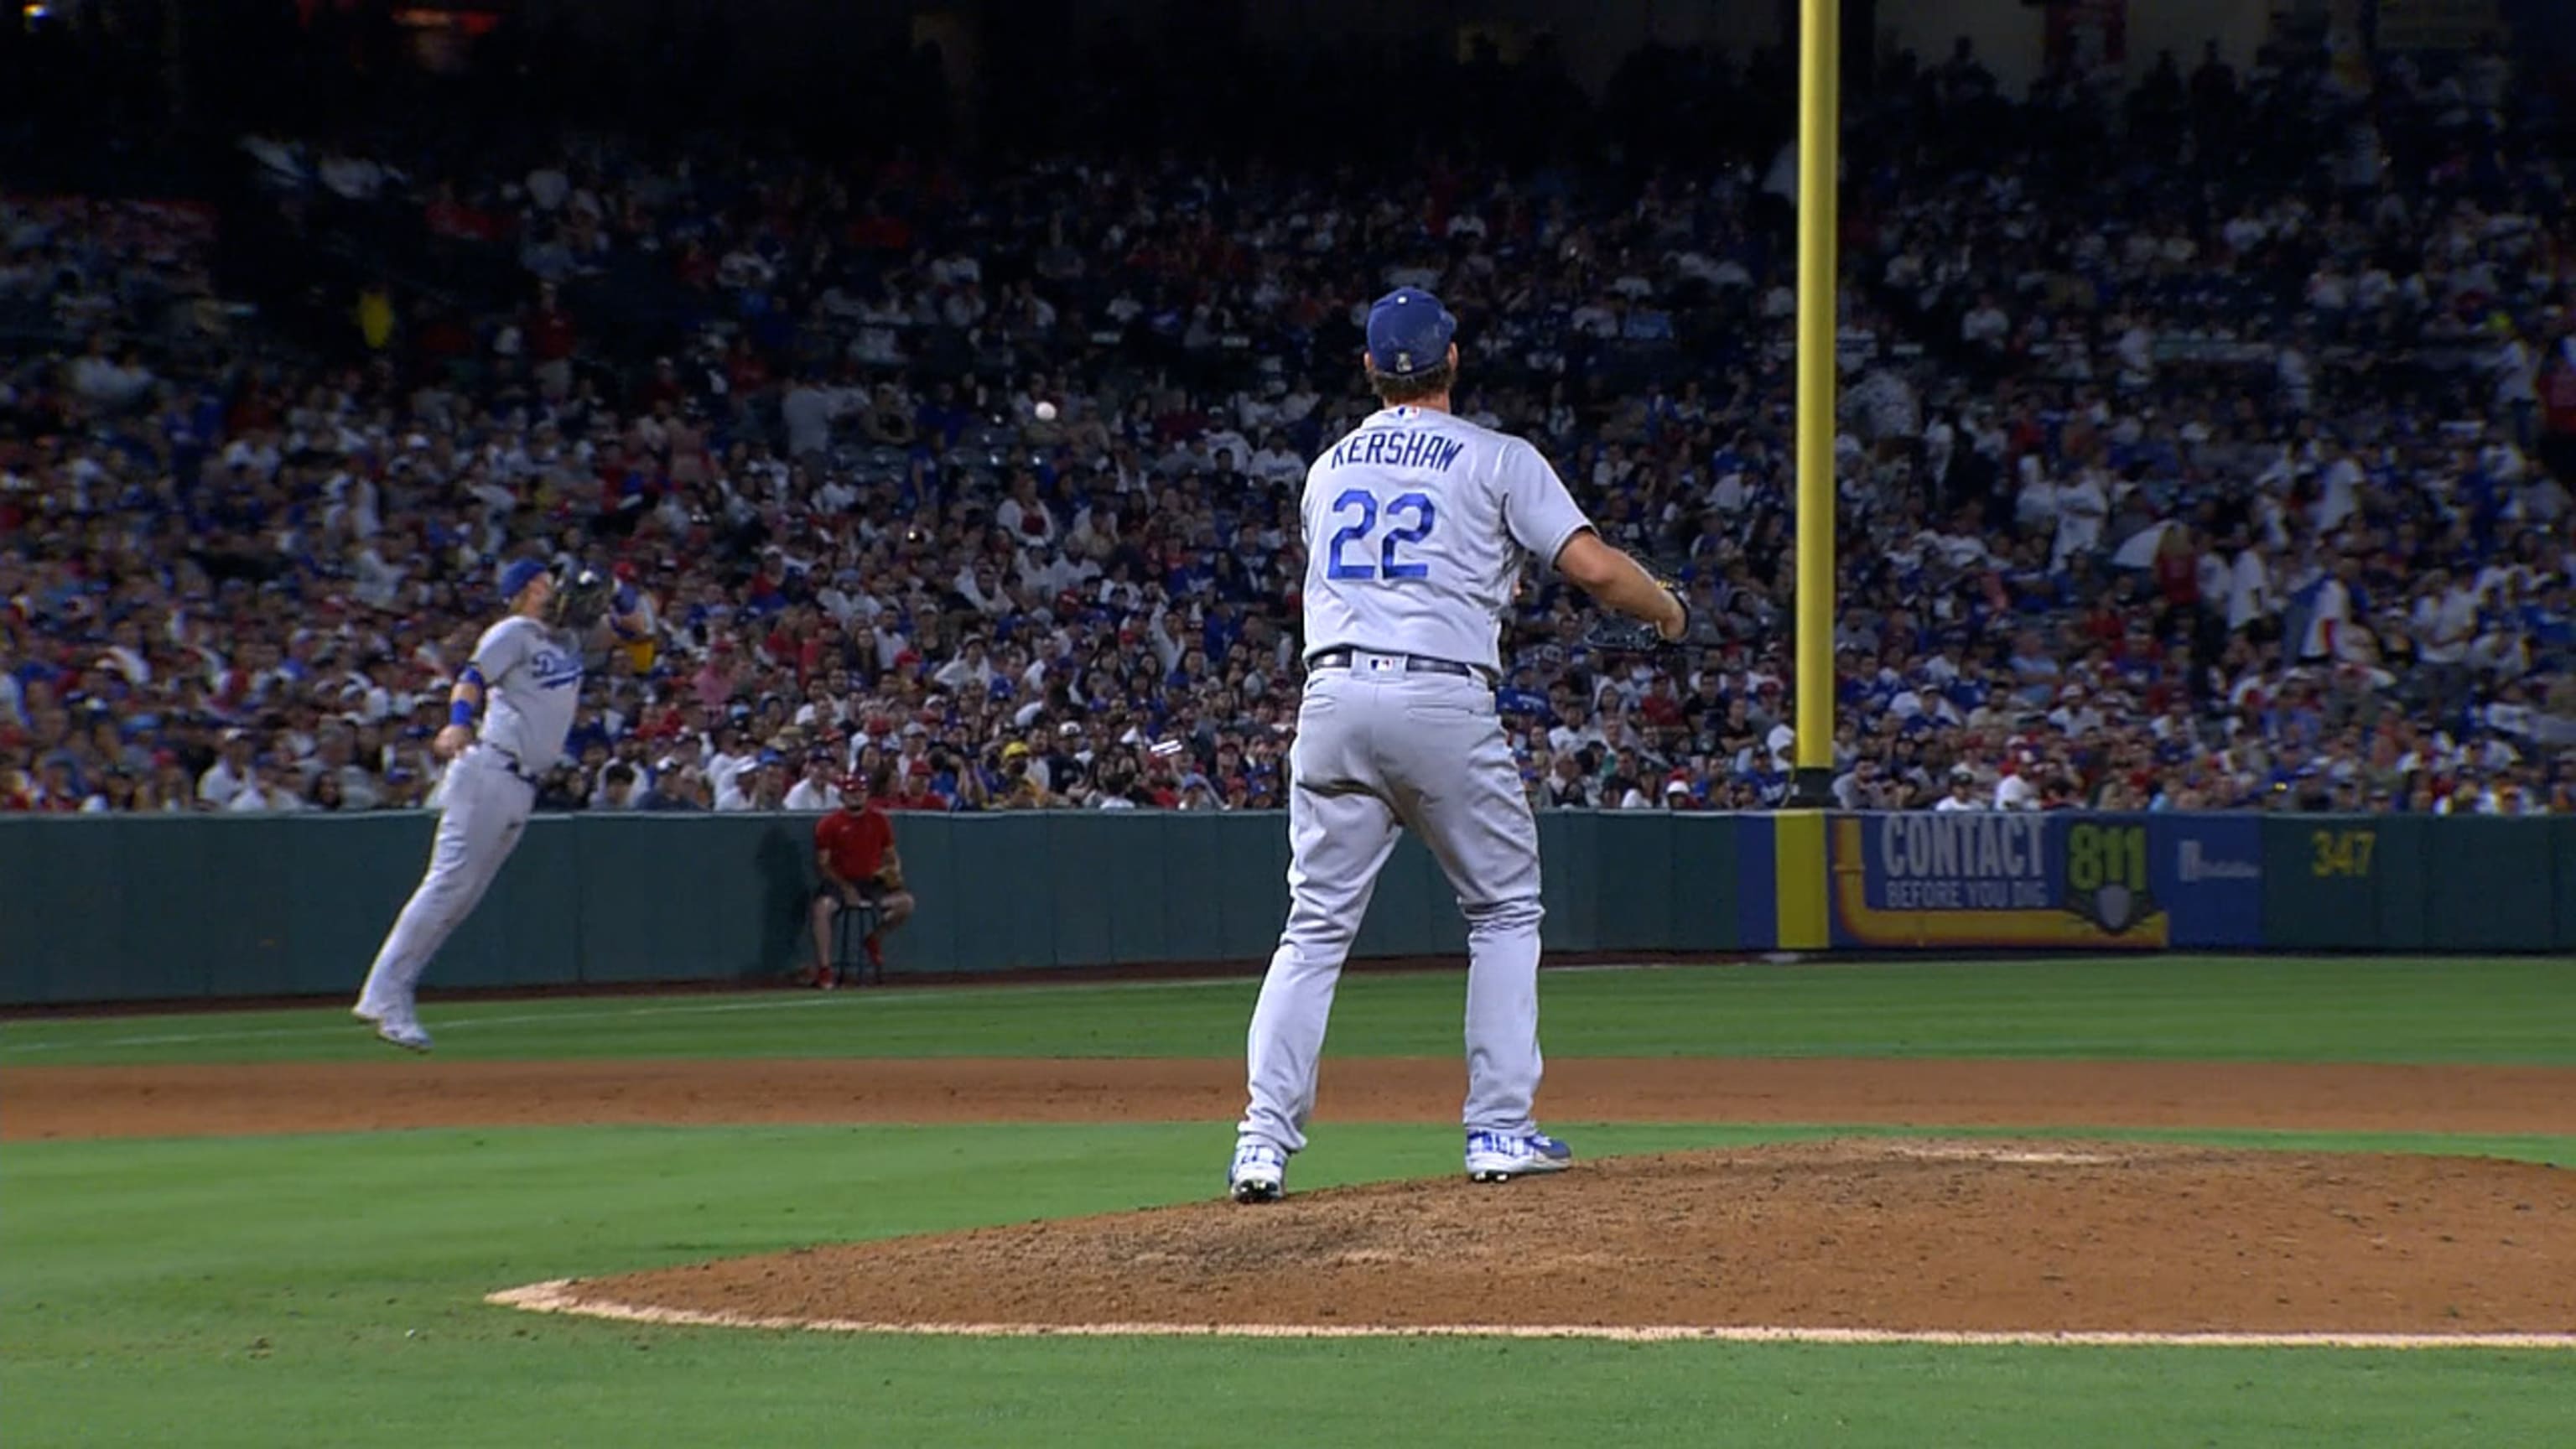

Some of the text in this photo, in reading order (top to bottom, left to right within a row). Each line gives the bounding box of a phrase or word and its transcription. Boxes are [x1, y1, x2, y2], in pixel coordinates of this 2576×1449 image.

[1331, 431, 1464, 472] KERSHAW
[1327, 488, 1435, 579] 22
[1882, 815, 2047, 877] CONTACT
[2069, 823, 2145, 891] 811
[2312, 829, 2376, 877] 347
[1887, 881, 2049, 908] BEFORE YOU DIG
